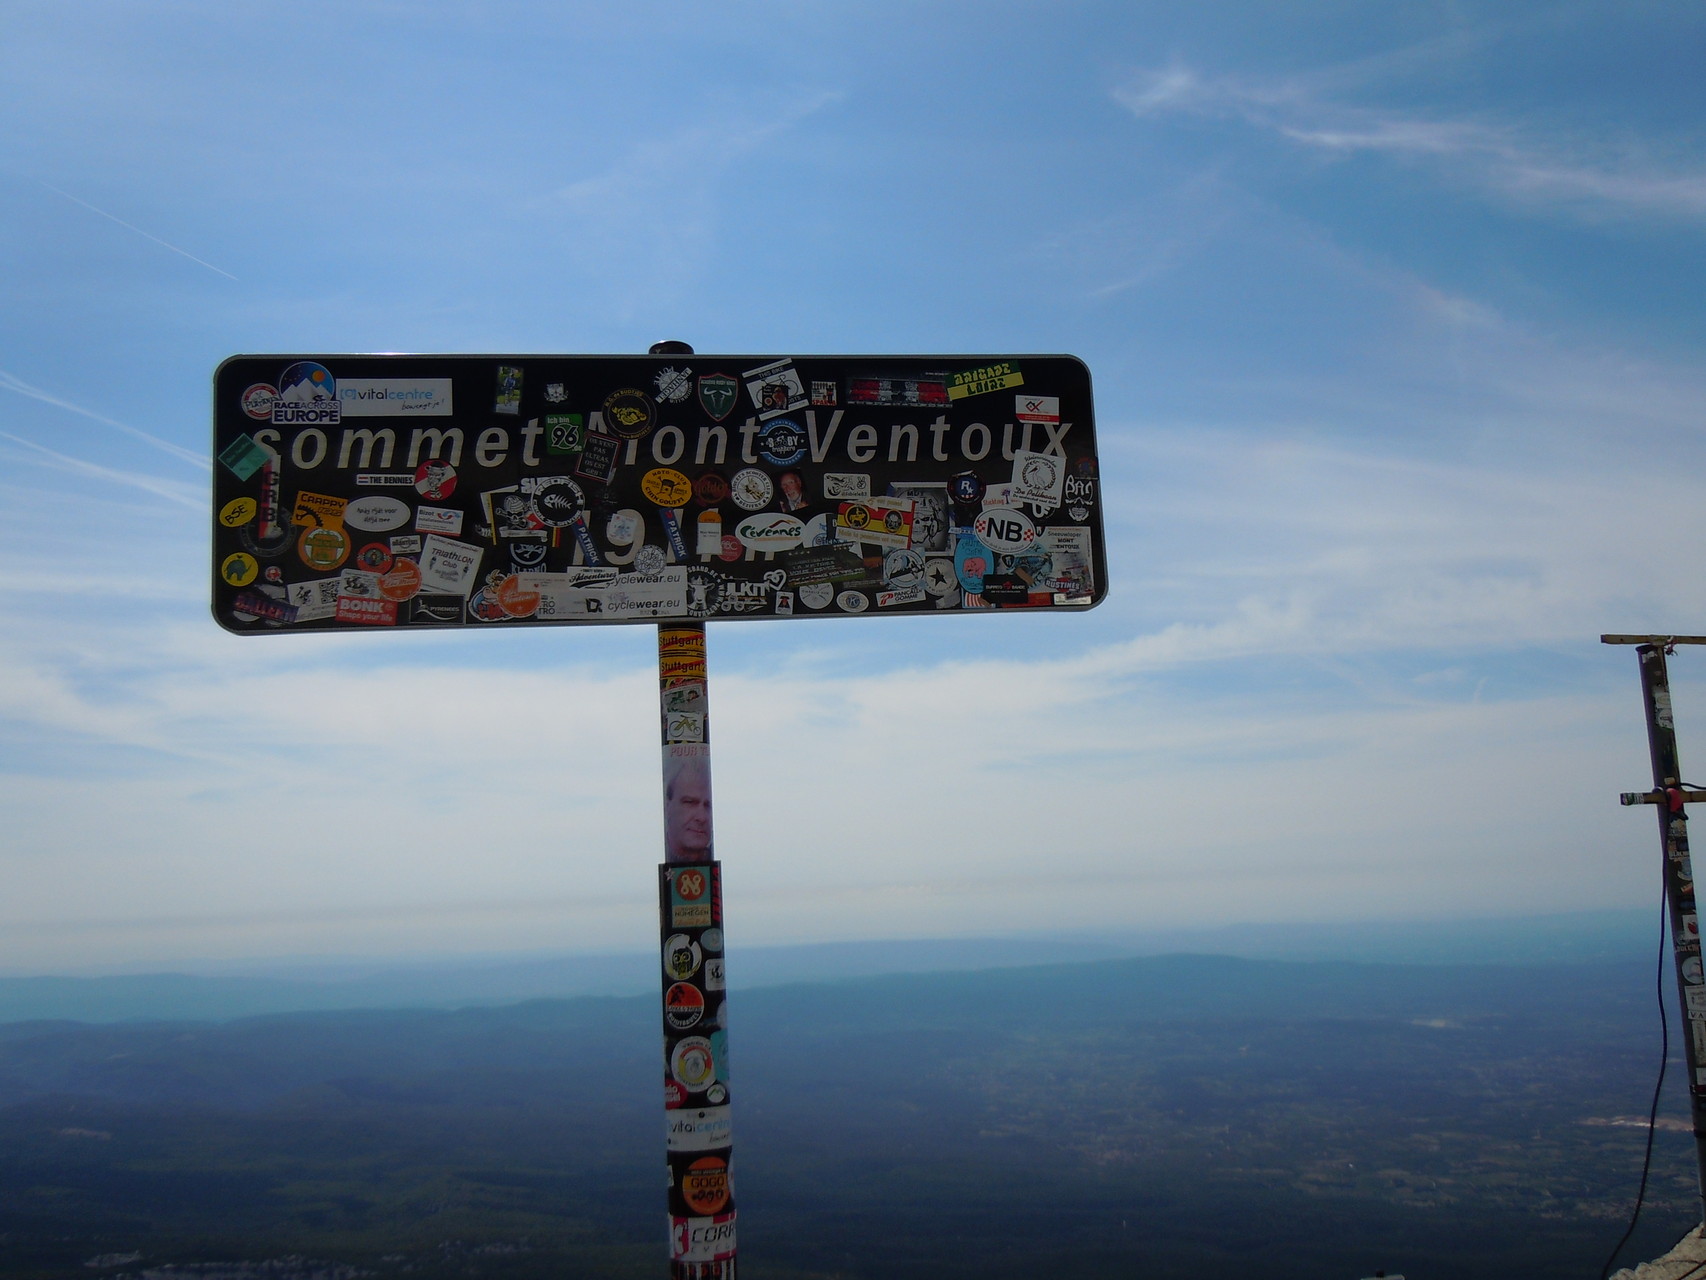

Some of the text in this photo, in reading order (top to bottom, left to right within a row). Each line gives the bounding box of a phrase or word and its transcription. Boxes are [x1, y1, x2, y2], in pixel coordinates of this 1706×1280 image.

[953, 362, 1012, 386] BRIGADE
[358, 388, 433, 400] vitalcentre
[966, 378, 1006, 396] LOIRE
[274, 410, 339, 422] EUROPE
[552, 426, 579, 448] 96
[805, 410, 1073, 464] Ventoux
[370, 476, 413, 484] THE BENNIES
[224, 503, 248, 525] BSE
[740, 524, 801, 539] Cévennes
[986, 517, 1022, 542] NB
[578, 526, 599, 564] PATRICK
[667, 520, 687, 558] PATRICK
[569, 572, 618, 584] Adventures
[340, 599, 384, 613] BONK
[607, 598, 680, 612] cyclewear.eu
[363, 613, 381, 621] your
[659, 633, 698, 648] Stuttgart
[661, 660, 700, 673] Stuttgart
